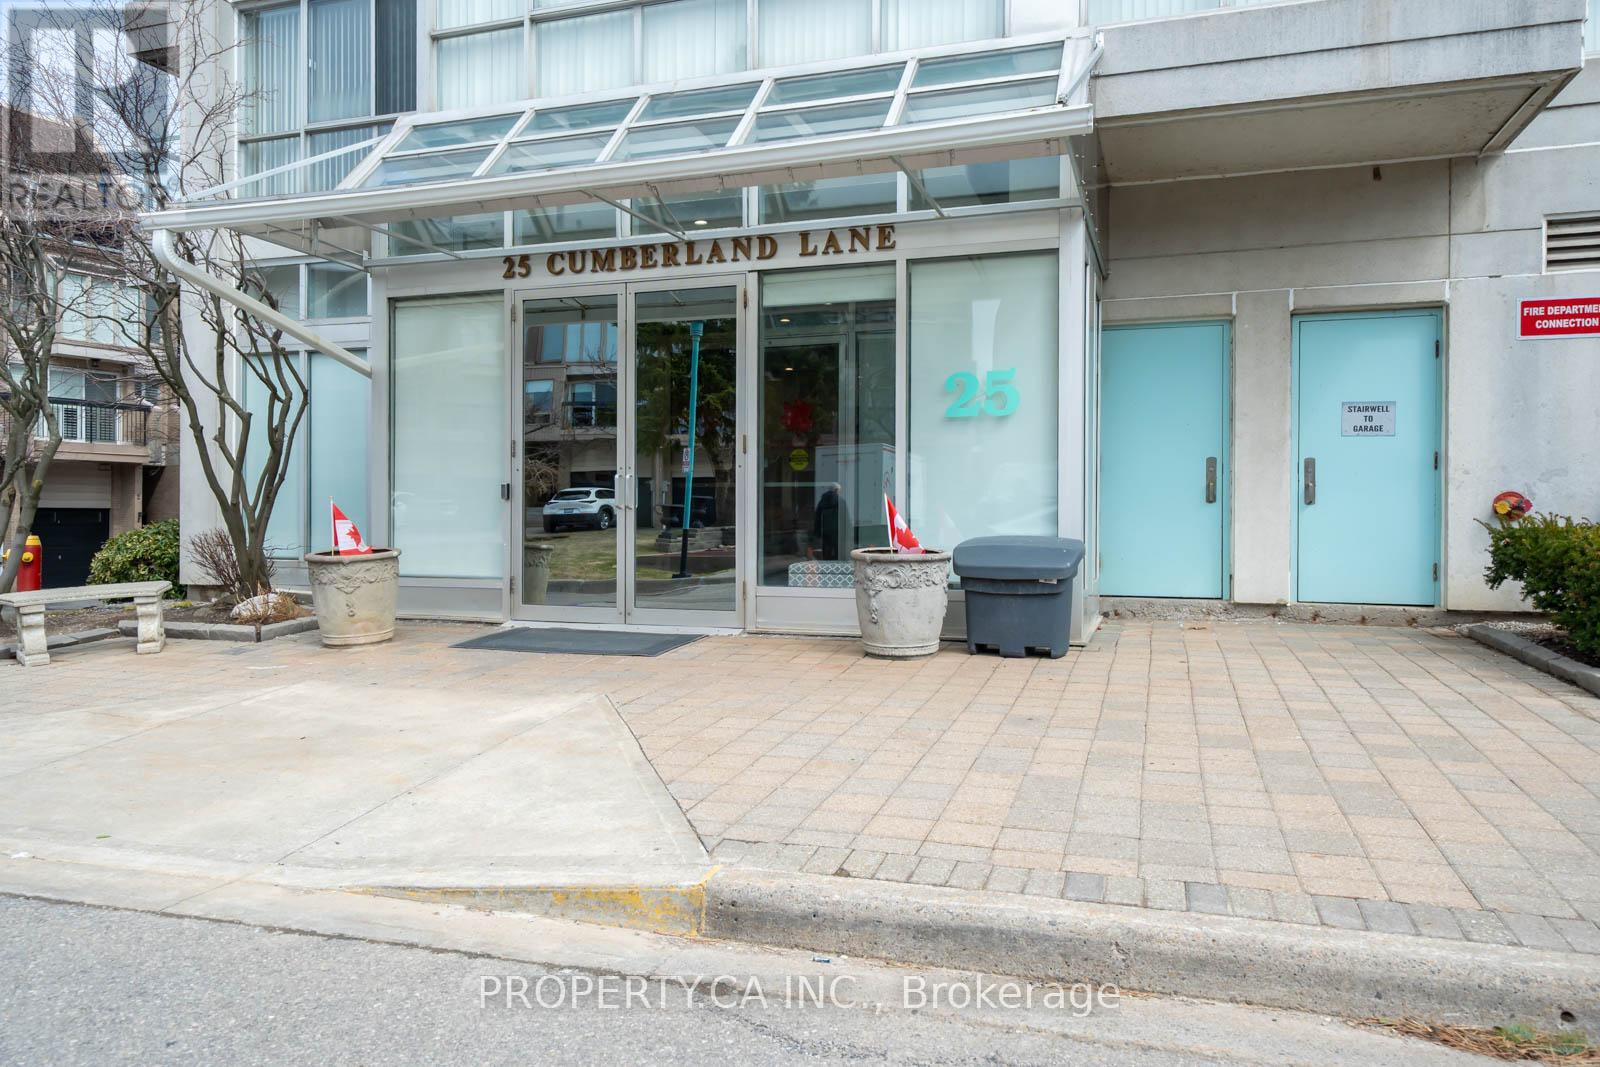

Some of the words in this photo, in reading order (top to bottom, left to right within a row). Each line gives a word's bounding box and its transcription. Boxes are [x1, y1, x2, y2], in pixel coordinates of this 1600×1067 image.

[502, 253, 532, 279] 25
[546, 235, 779, 276] CUMBERLAND
[799, 224, 897, 257] LANE
[1523, 307, 1545, 316] FIRE
[1547, 304, 1600, 315] DEPARTME
[1535, 318, 1599, 329] CONNECTION
[944, 367, 1021, 418] 25
[1347, 405, 1390, 413] STAIRWELL
